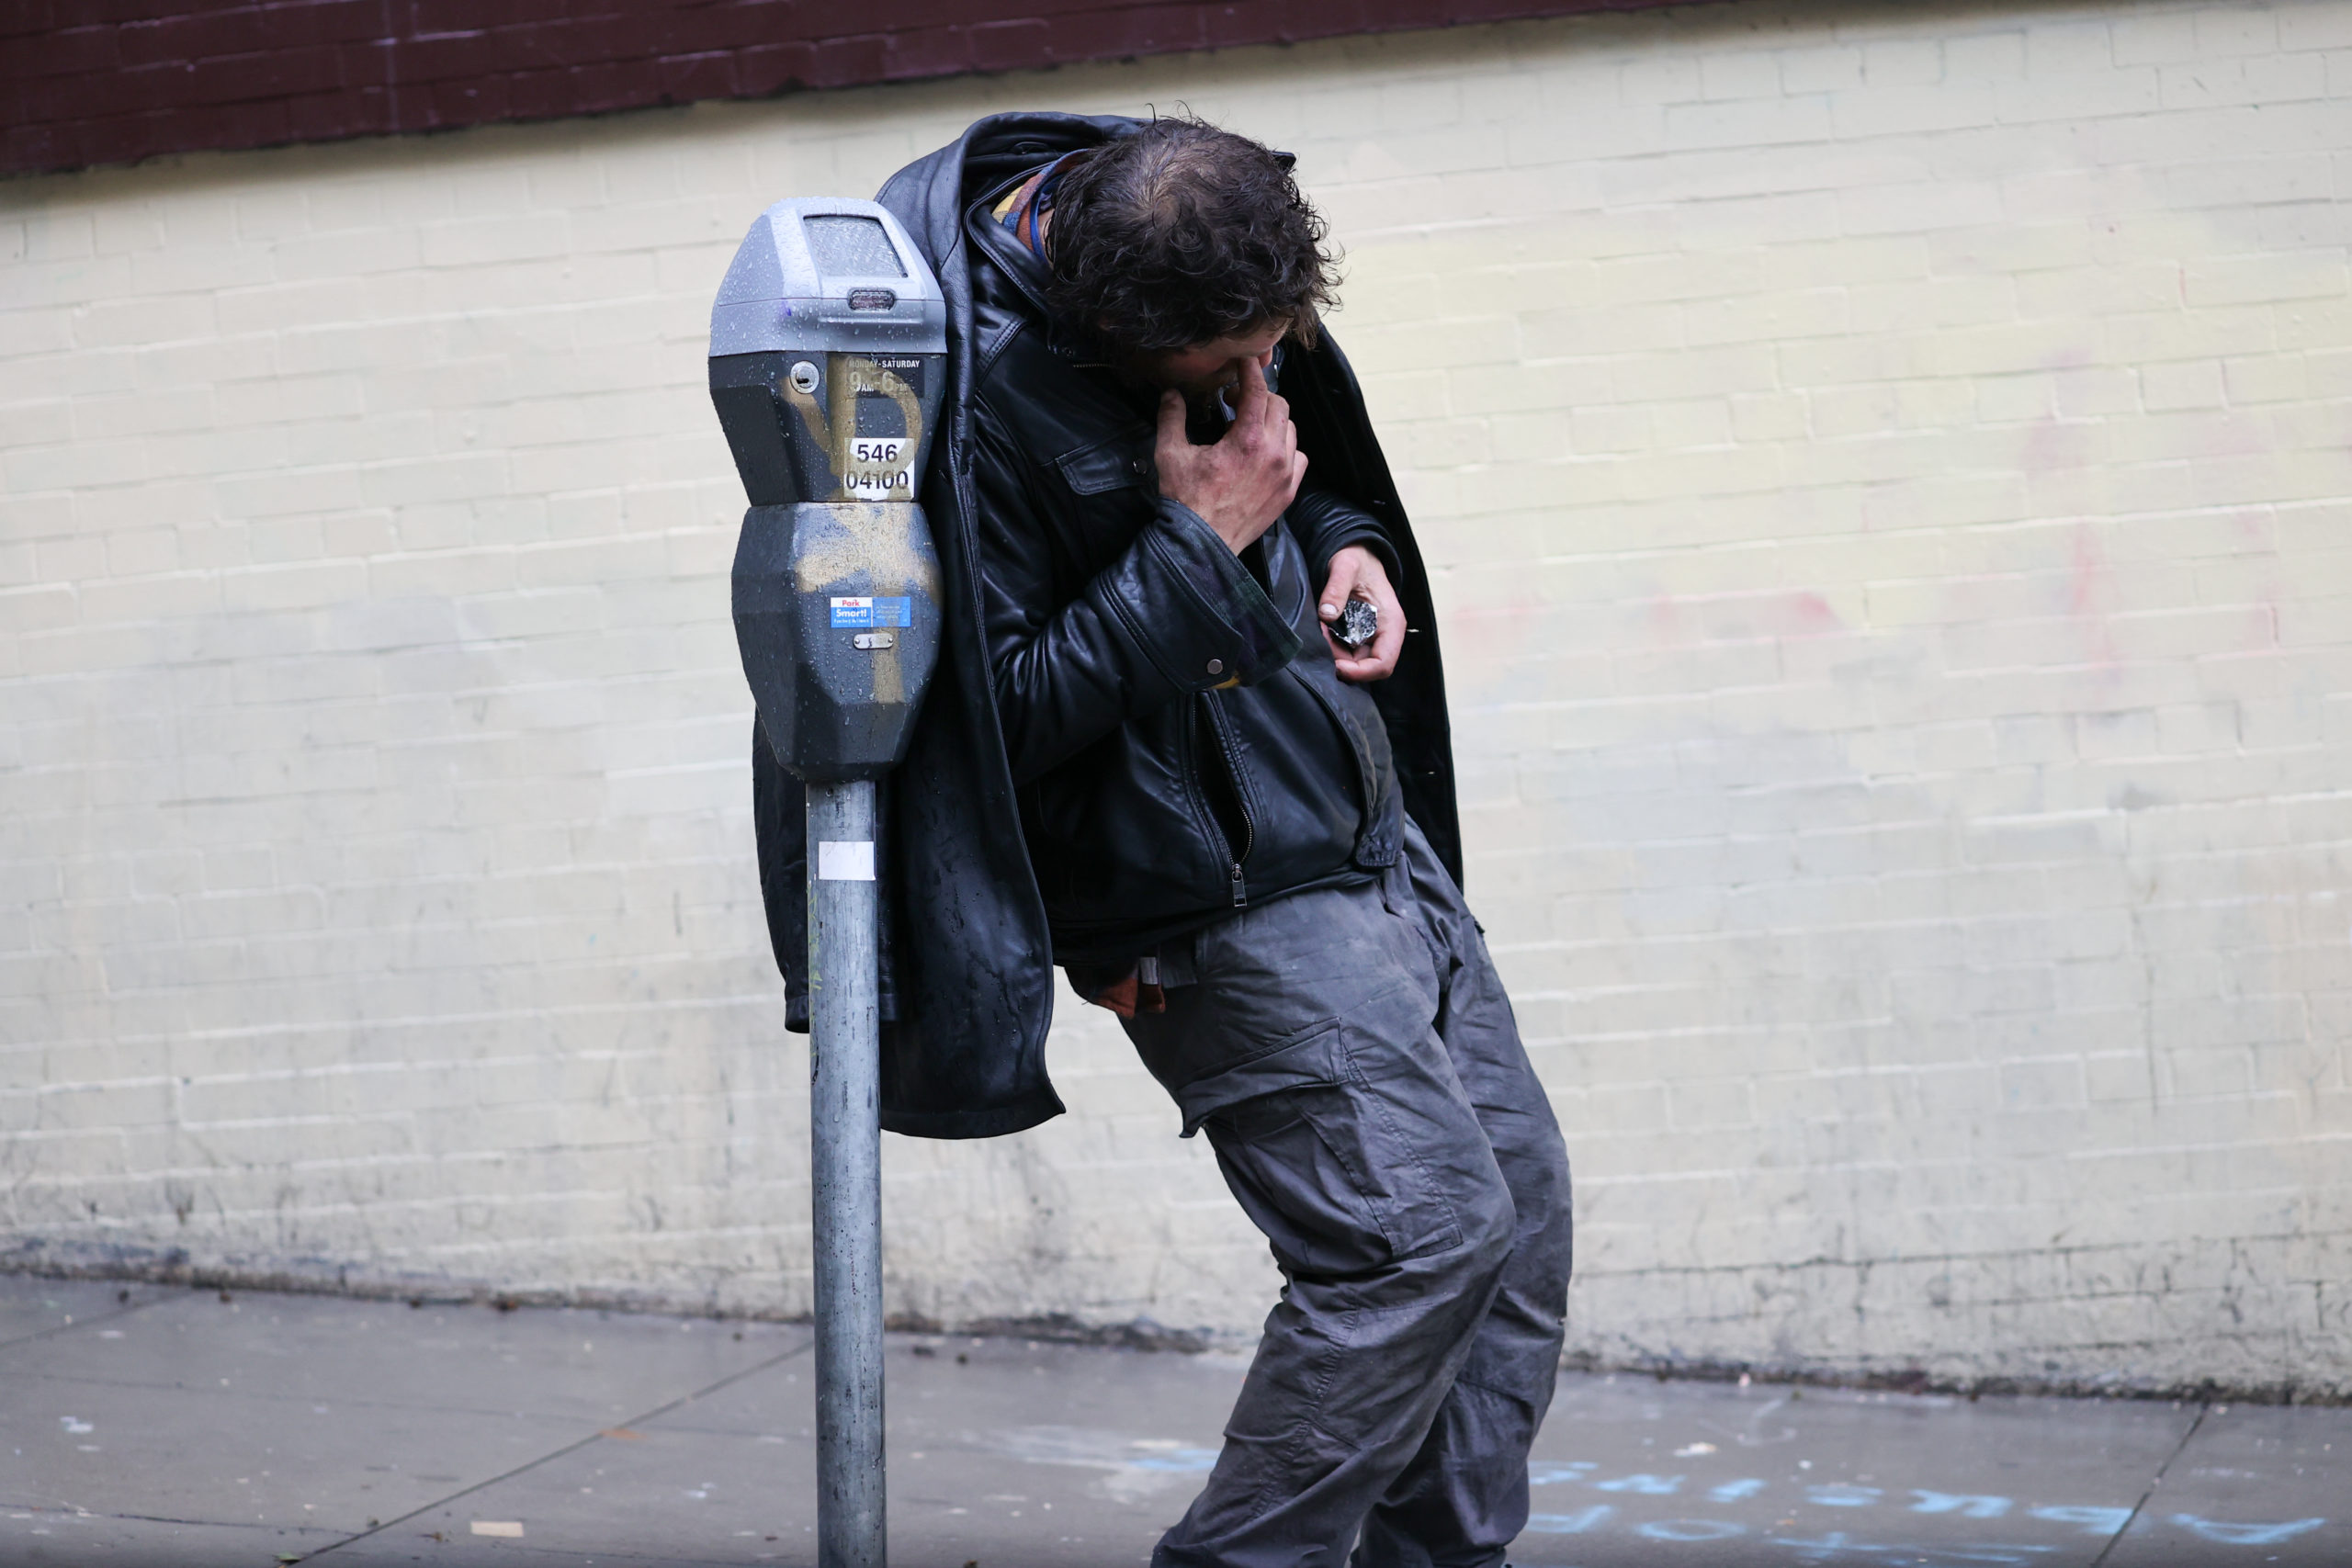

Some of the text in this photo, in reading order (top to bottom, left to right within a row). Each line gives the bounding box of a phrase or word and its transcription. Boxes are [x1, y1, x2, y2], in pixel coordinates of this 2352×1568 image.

[849, 359, 921, 368] MONDAY-SATURDAY
[857, 444, 898, 463] 546
[846, 470, 909, 490] 04100
[842, 599, 860, 607] Park
[836, 608, 867, 617] Smart!
